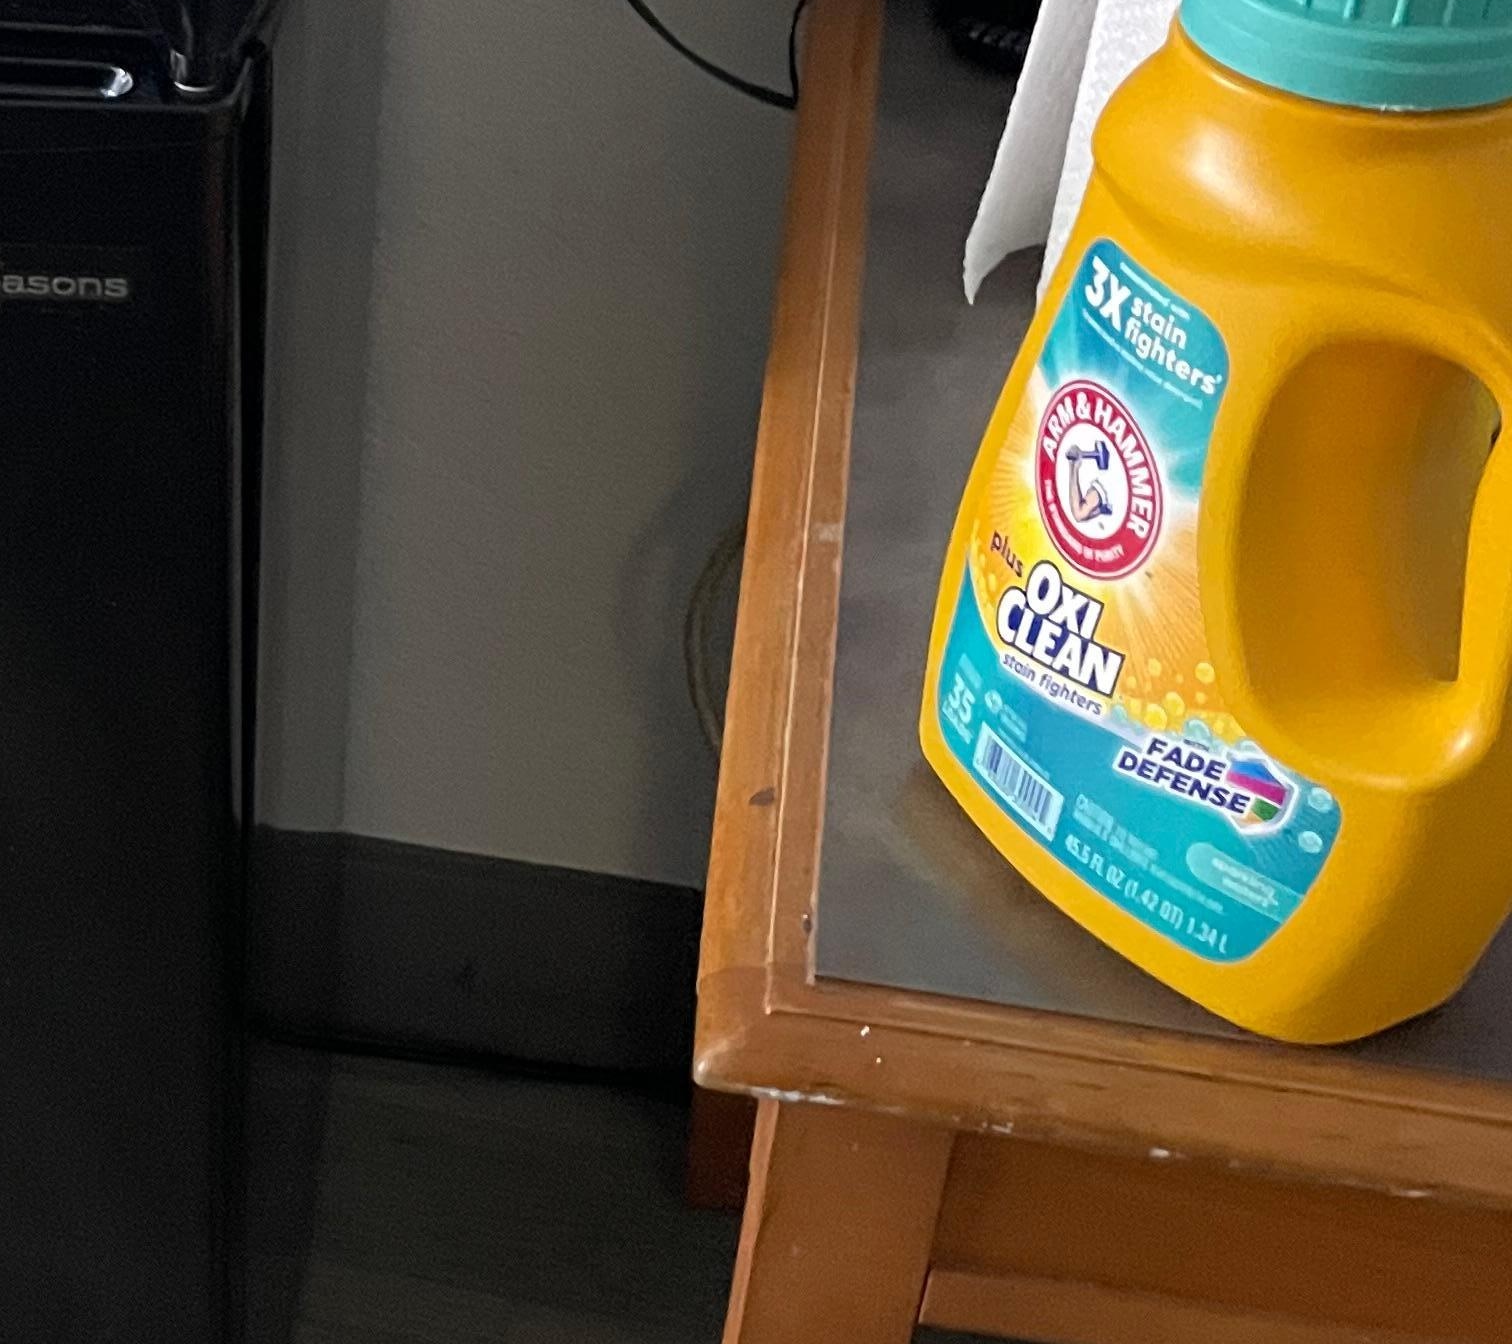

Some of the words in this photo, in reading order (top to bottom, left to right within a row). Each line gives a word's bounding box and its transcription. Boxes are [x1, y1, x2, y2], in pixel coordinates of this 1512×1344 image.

[1085, 255, 1131, 332] 3X
[1131, 297, 1187, 350] stain
[1043, 396, 1075, 463] ARM
[1076, 391, 1092, 421] &
[1094, 397, 1153, 539] HAMMER
[990, 531, 1024, 578] plus
[1027, 561, 1104, 639] OXI
[997, 587, 1125, 698] CLEAN
[948, 672, 976, 724] 35
[1003, 653, 1036, 682] stain
[1039, 673, 1103, 715] fighters
[1118, 751, 1251, 814] DEFENSE
[1146, 737, 1226, 781] FADE
